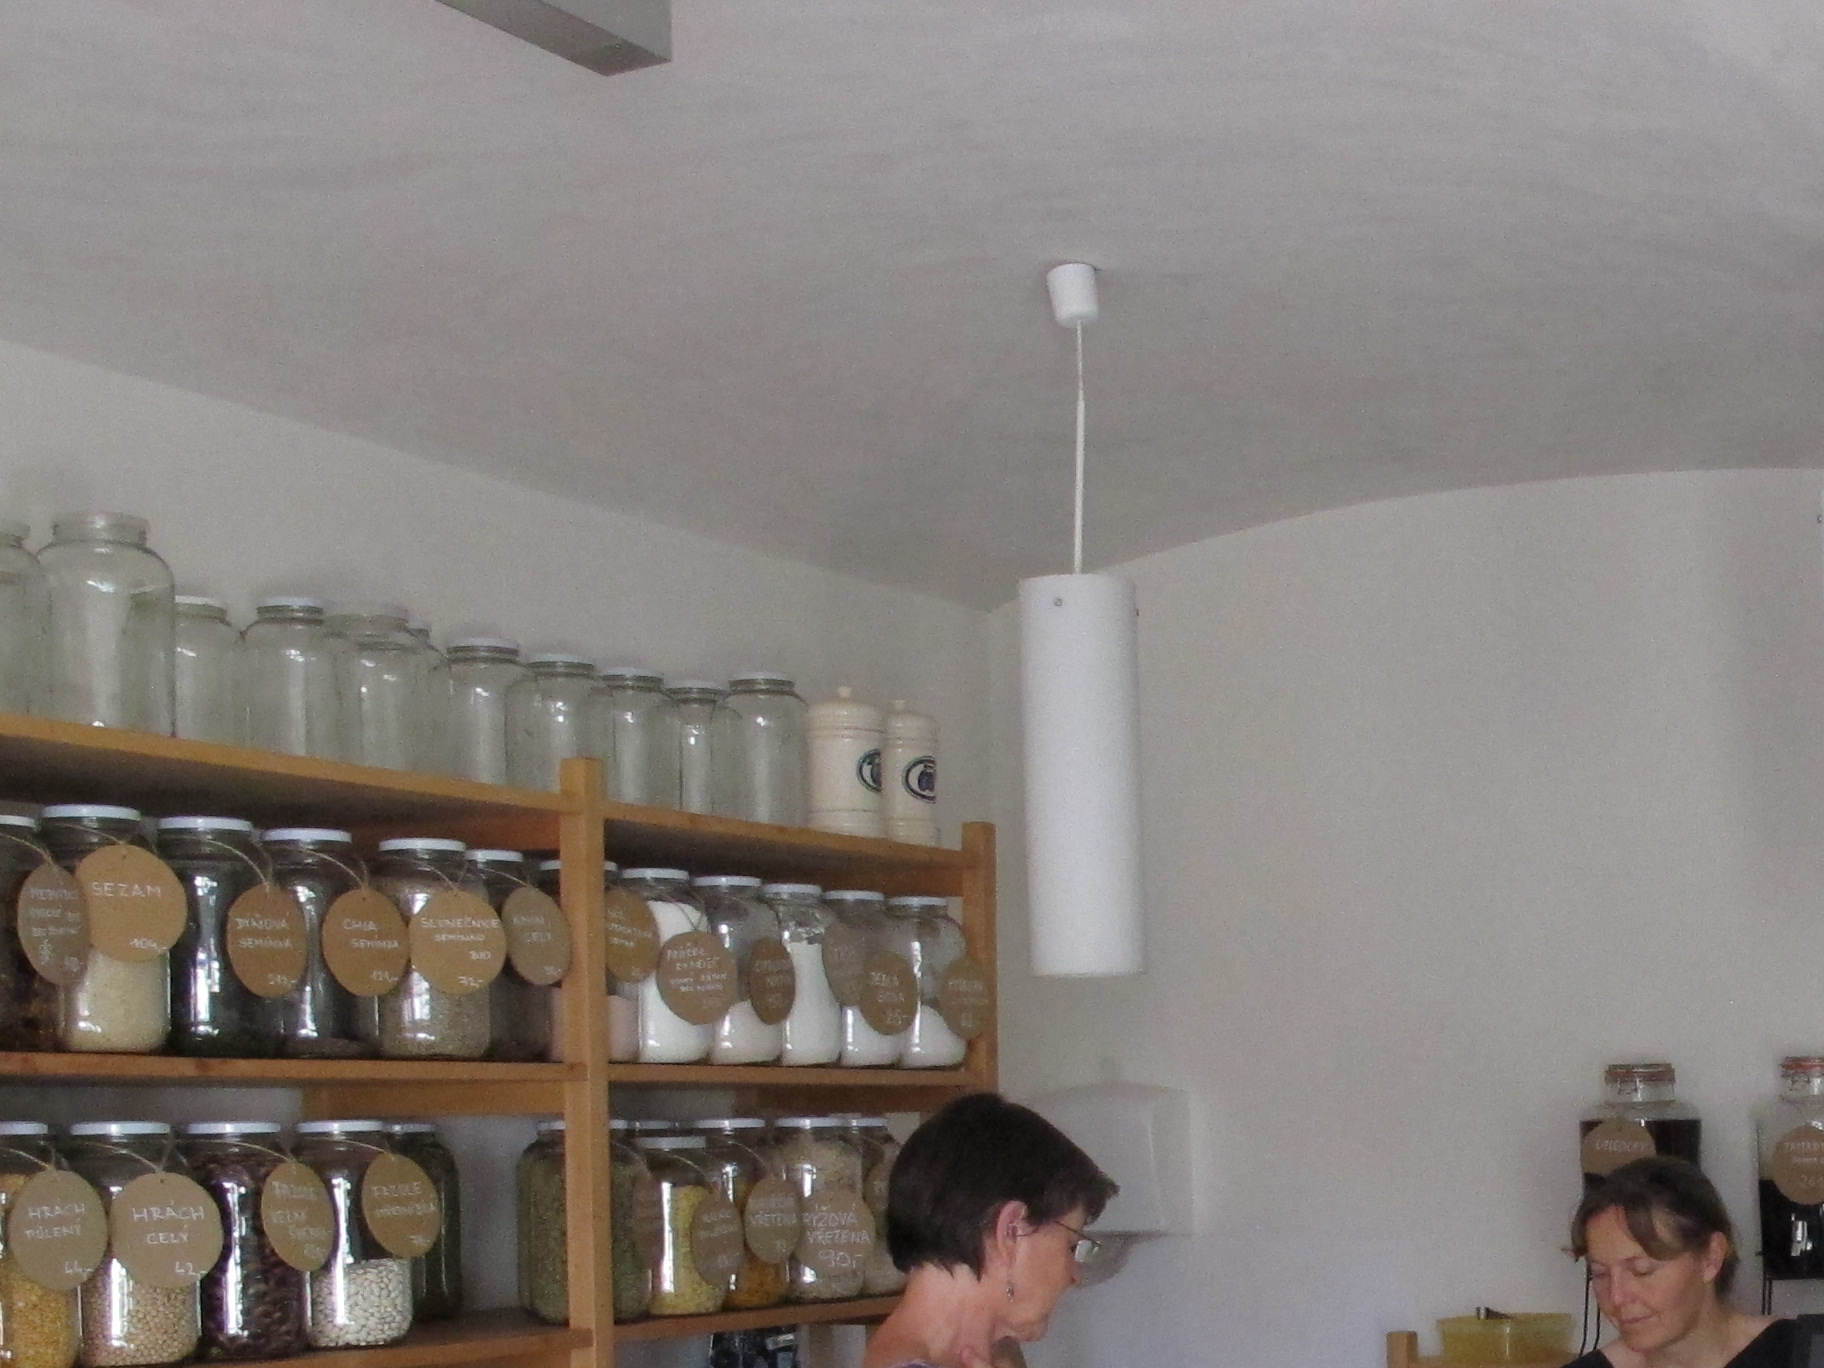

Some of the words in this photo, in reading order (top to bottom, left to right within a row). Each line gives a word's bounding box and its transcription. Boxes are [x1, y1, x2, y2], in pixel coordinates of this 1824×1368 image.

[92, 882, 161, 898] SEZAM
[343, 919, 378, 931] CHIA
[28, 1199, 85, 1219] HRÁCH
[132, 1200, 205, 1222] HRÁCH
[147, 1224, 190, 1245] CELÝ
